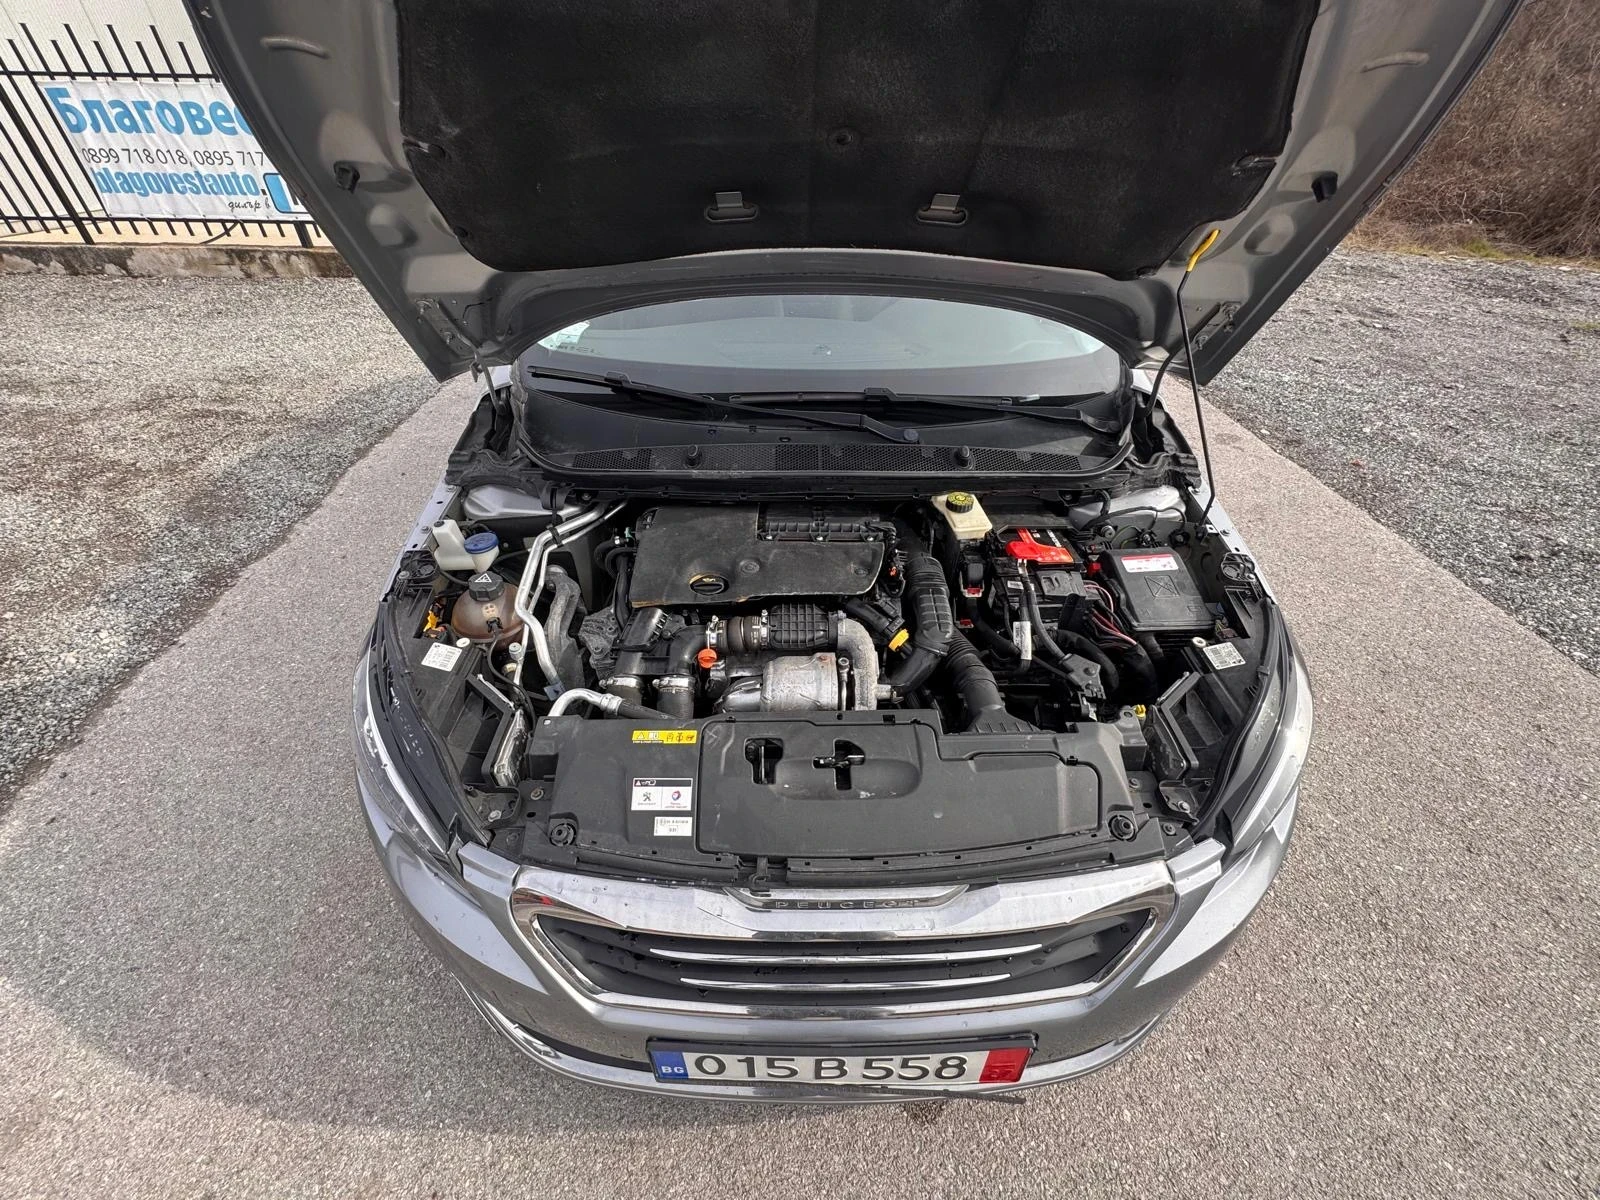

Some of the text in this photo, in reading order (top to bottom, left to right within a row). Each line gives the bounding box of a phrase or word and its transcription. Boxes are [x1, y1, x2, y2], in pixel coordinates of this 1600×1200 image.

[82, 147, 264, 168] 0899 718 018, 0895 717
[660, 1065, 685, 1074] BG
